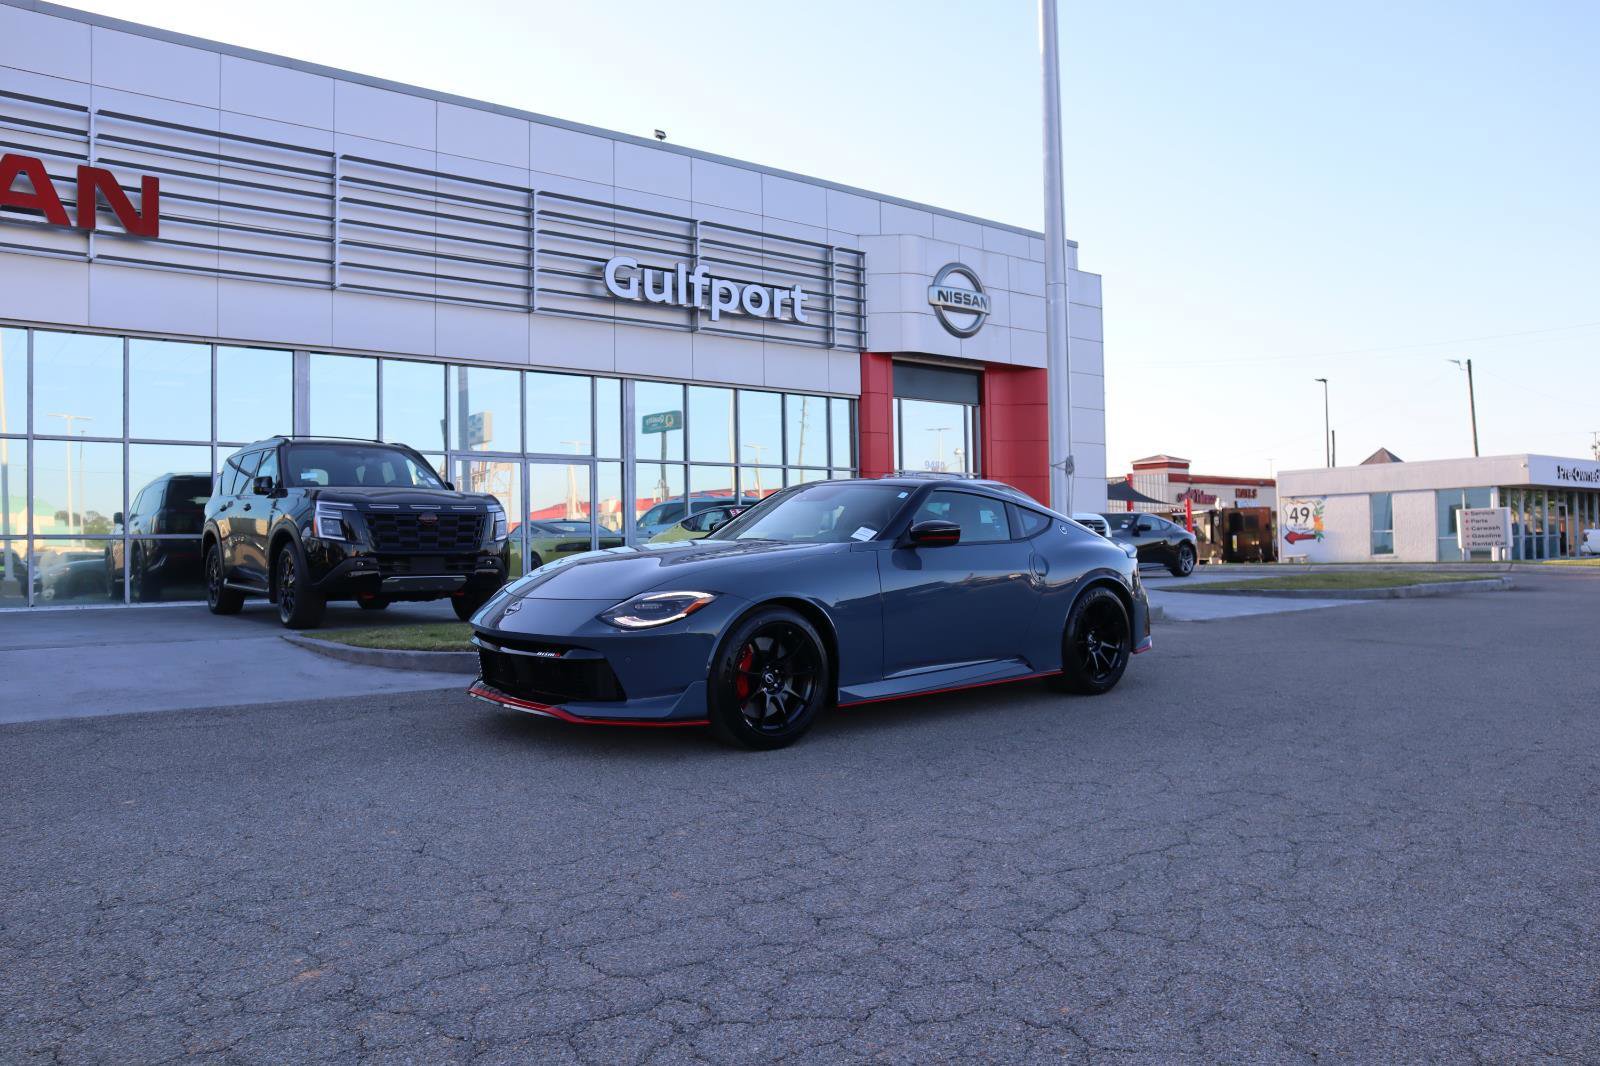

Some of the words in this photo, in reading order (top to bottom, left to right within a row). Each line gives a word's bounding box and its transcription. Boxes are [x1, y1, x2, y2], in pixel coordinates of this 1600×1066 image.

[0, 153, 160, 238] AN
[604, 256, 810, 323] Gulfport
[937, 290, 988, 310] NISSAN
[1289, 507, 1310, 524] 49
